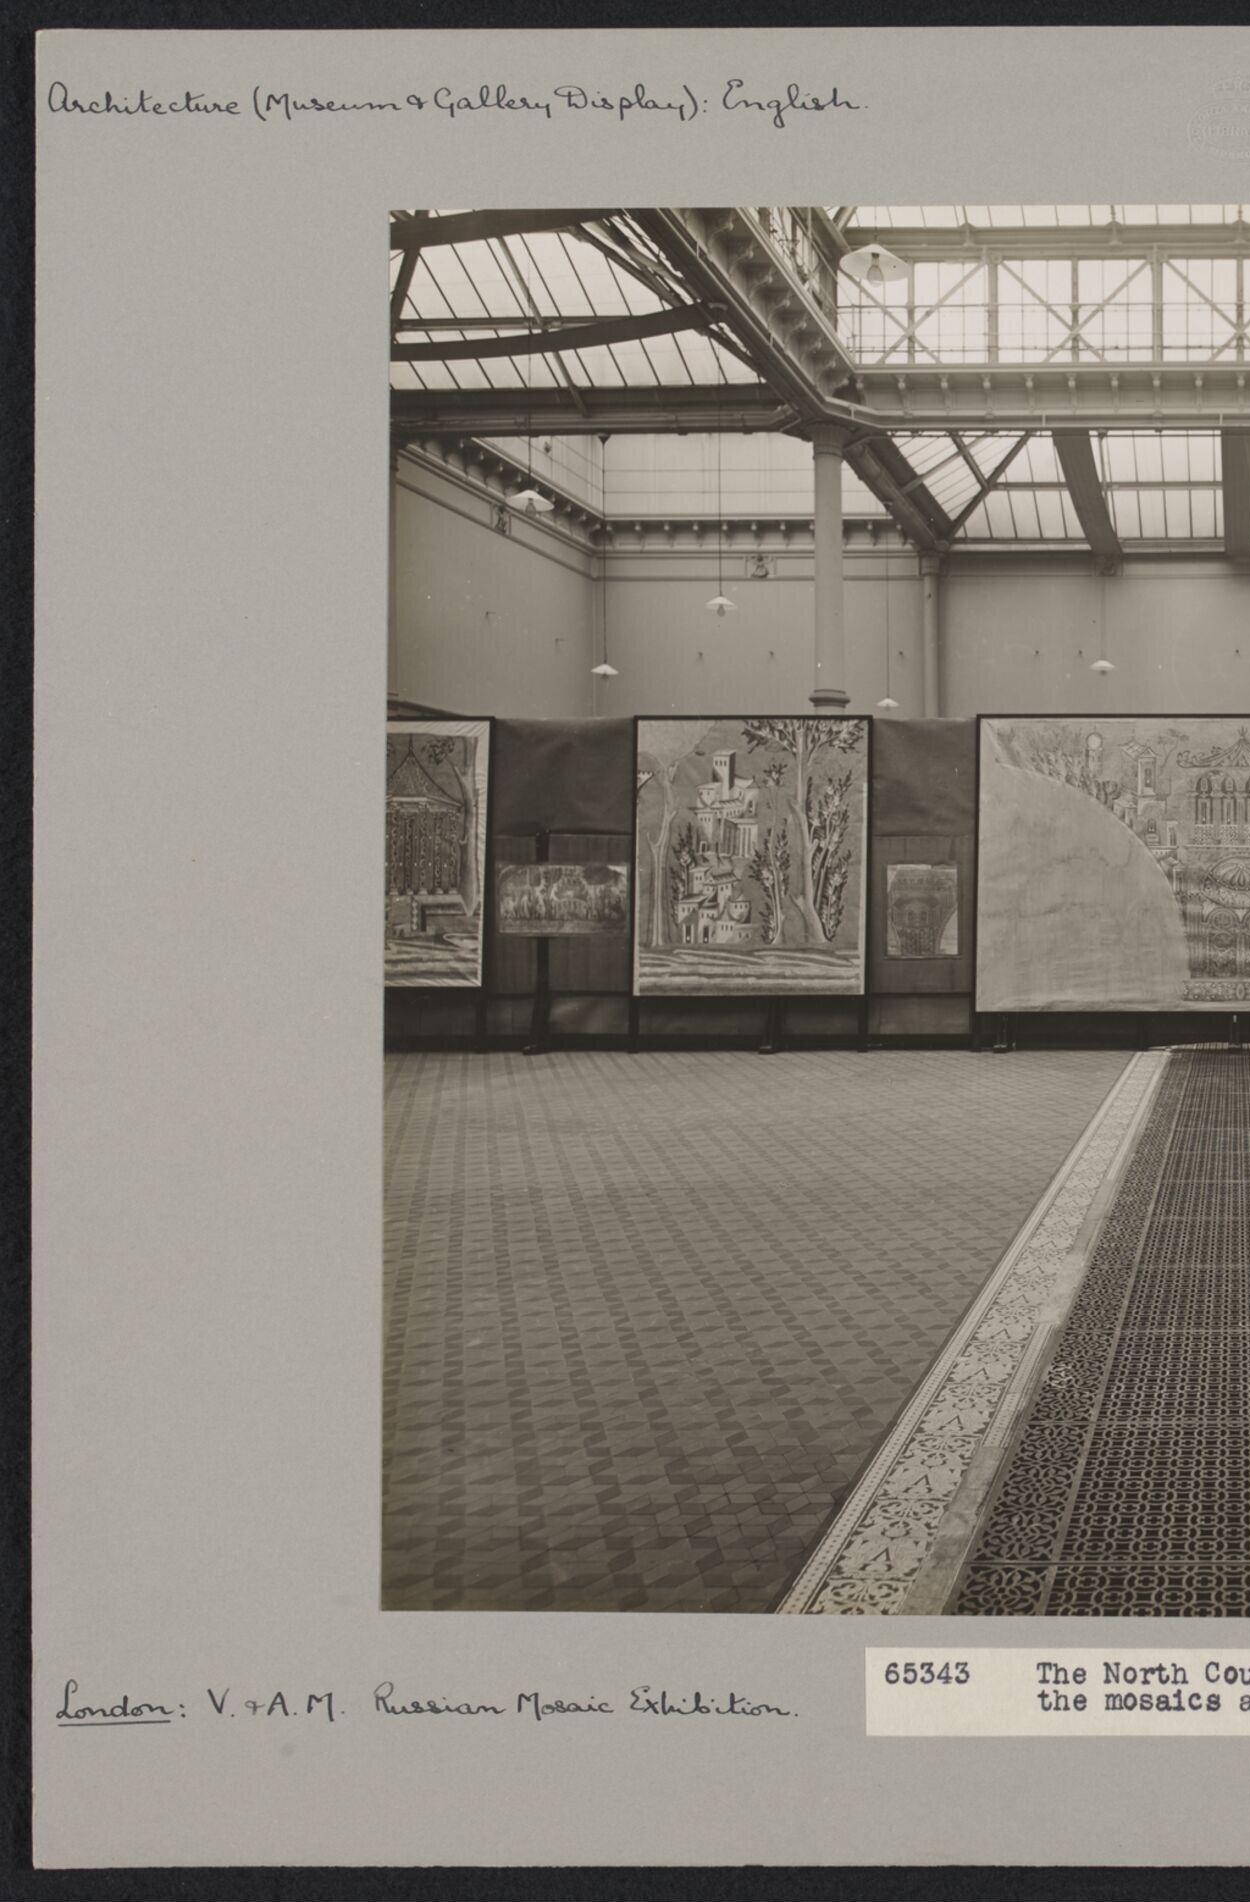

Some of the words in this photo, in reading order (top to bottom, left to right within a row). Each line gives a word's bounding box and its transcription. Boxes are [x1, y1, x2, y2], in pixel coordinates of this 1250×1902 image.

[47, 81, 241, 116] Architecture
[252, 85, 402, 122] (Museum
[433, 83, 552, 119] Gallery
[553, 83, 708, 122] Display):
[884, 1661, 971, 1685] 65343
[1036, 1661, 1087, 1685] The
[1102, 1661, 1189, 1686] North
[56, 1678, 186, 1721] London:
[374, 1681, 507, 1716] Russian
[517, 1691, 615, 1722] Mosaic
[629, 1685, 799, 1717] Exhibition.
[1036, 1689, 1088, 1712] the
[1104, 1688, 1222, 1713] mosaics
